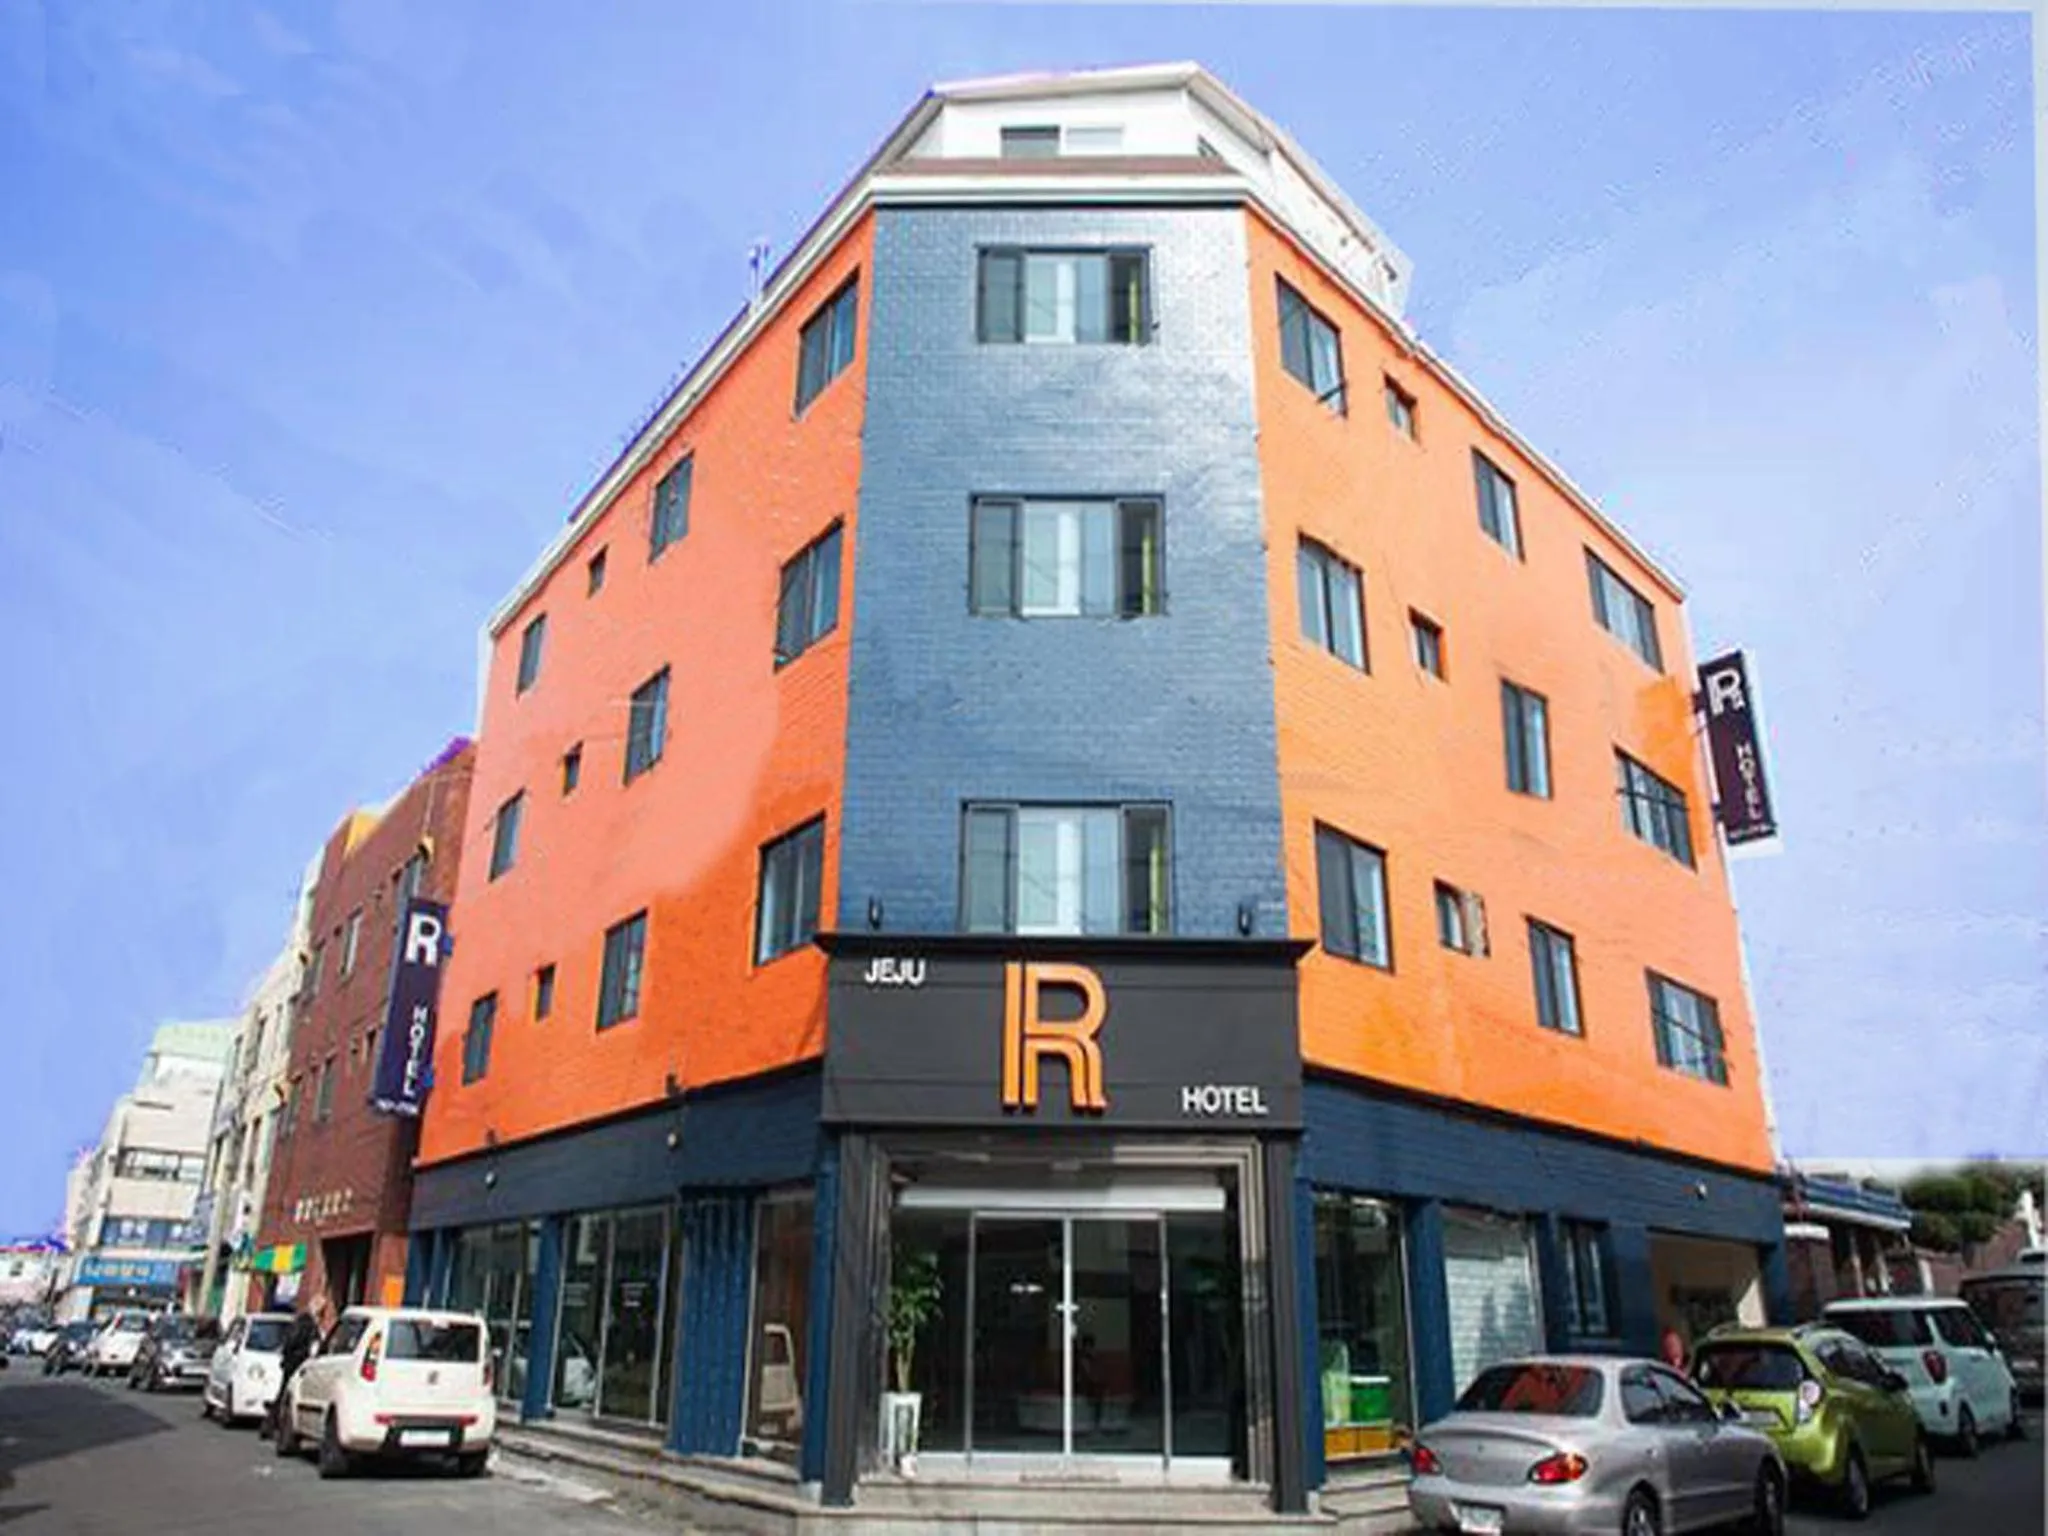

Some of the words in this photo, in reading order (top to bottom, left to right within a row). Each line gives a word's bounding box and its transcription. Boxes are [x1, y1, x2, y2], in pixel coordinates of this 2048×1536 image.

[405, 912, 441, 966] R
[864, 958, 926, 985] JEJU
[403, 1006, 428, 1096] HOTEL
[1180, 1086, 1269, 1115] HOTEL
